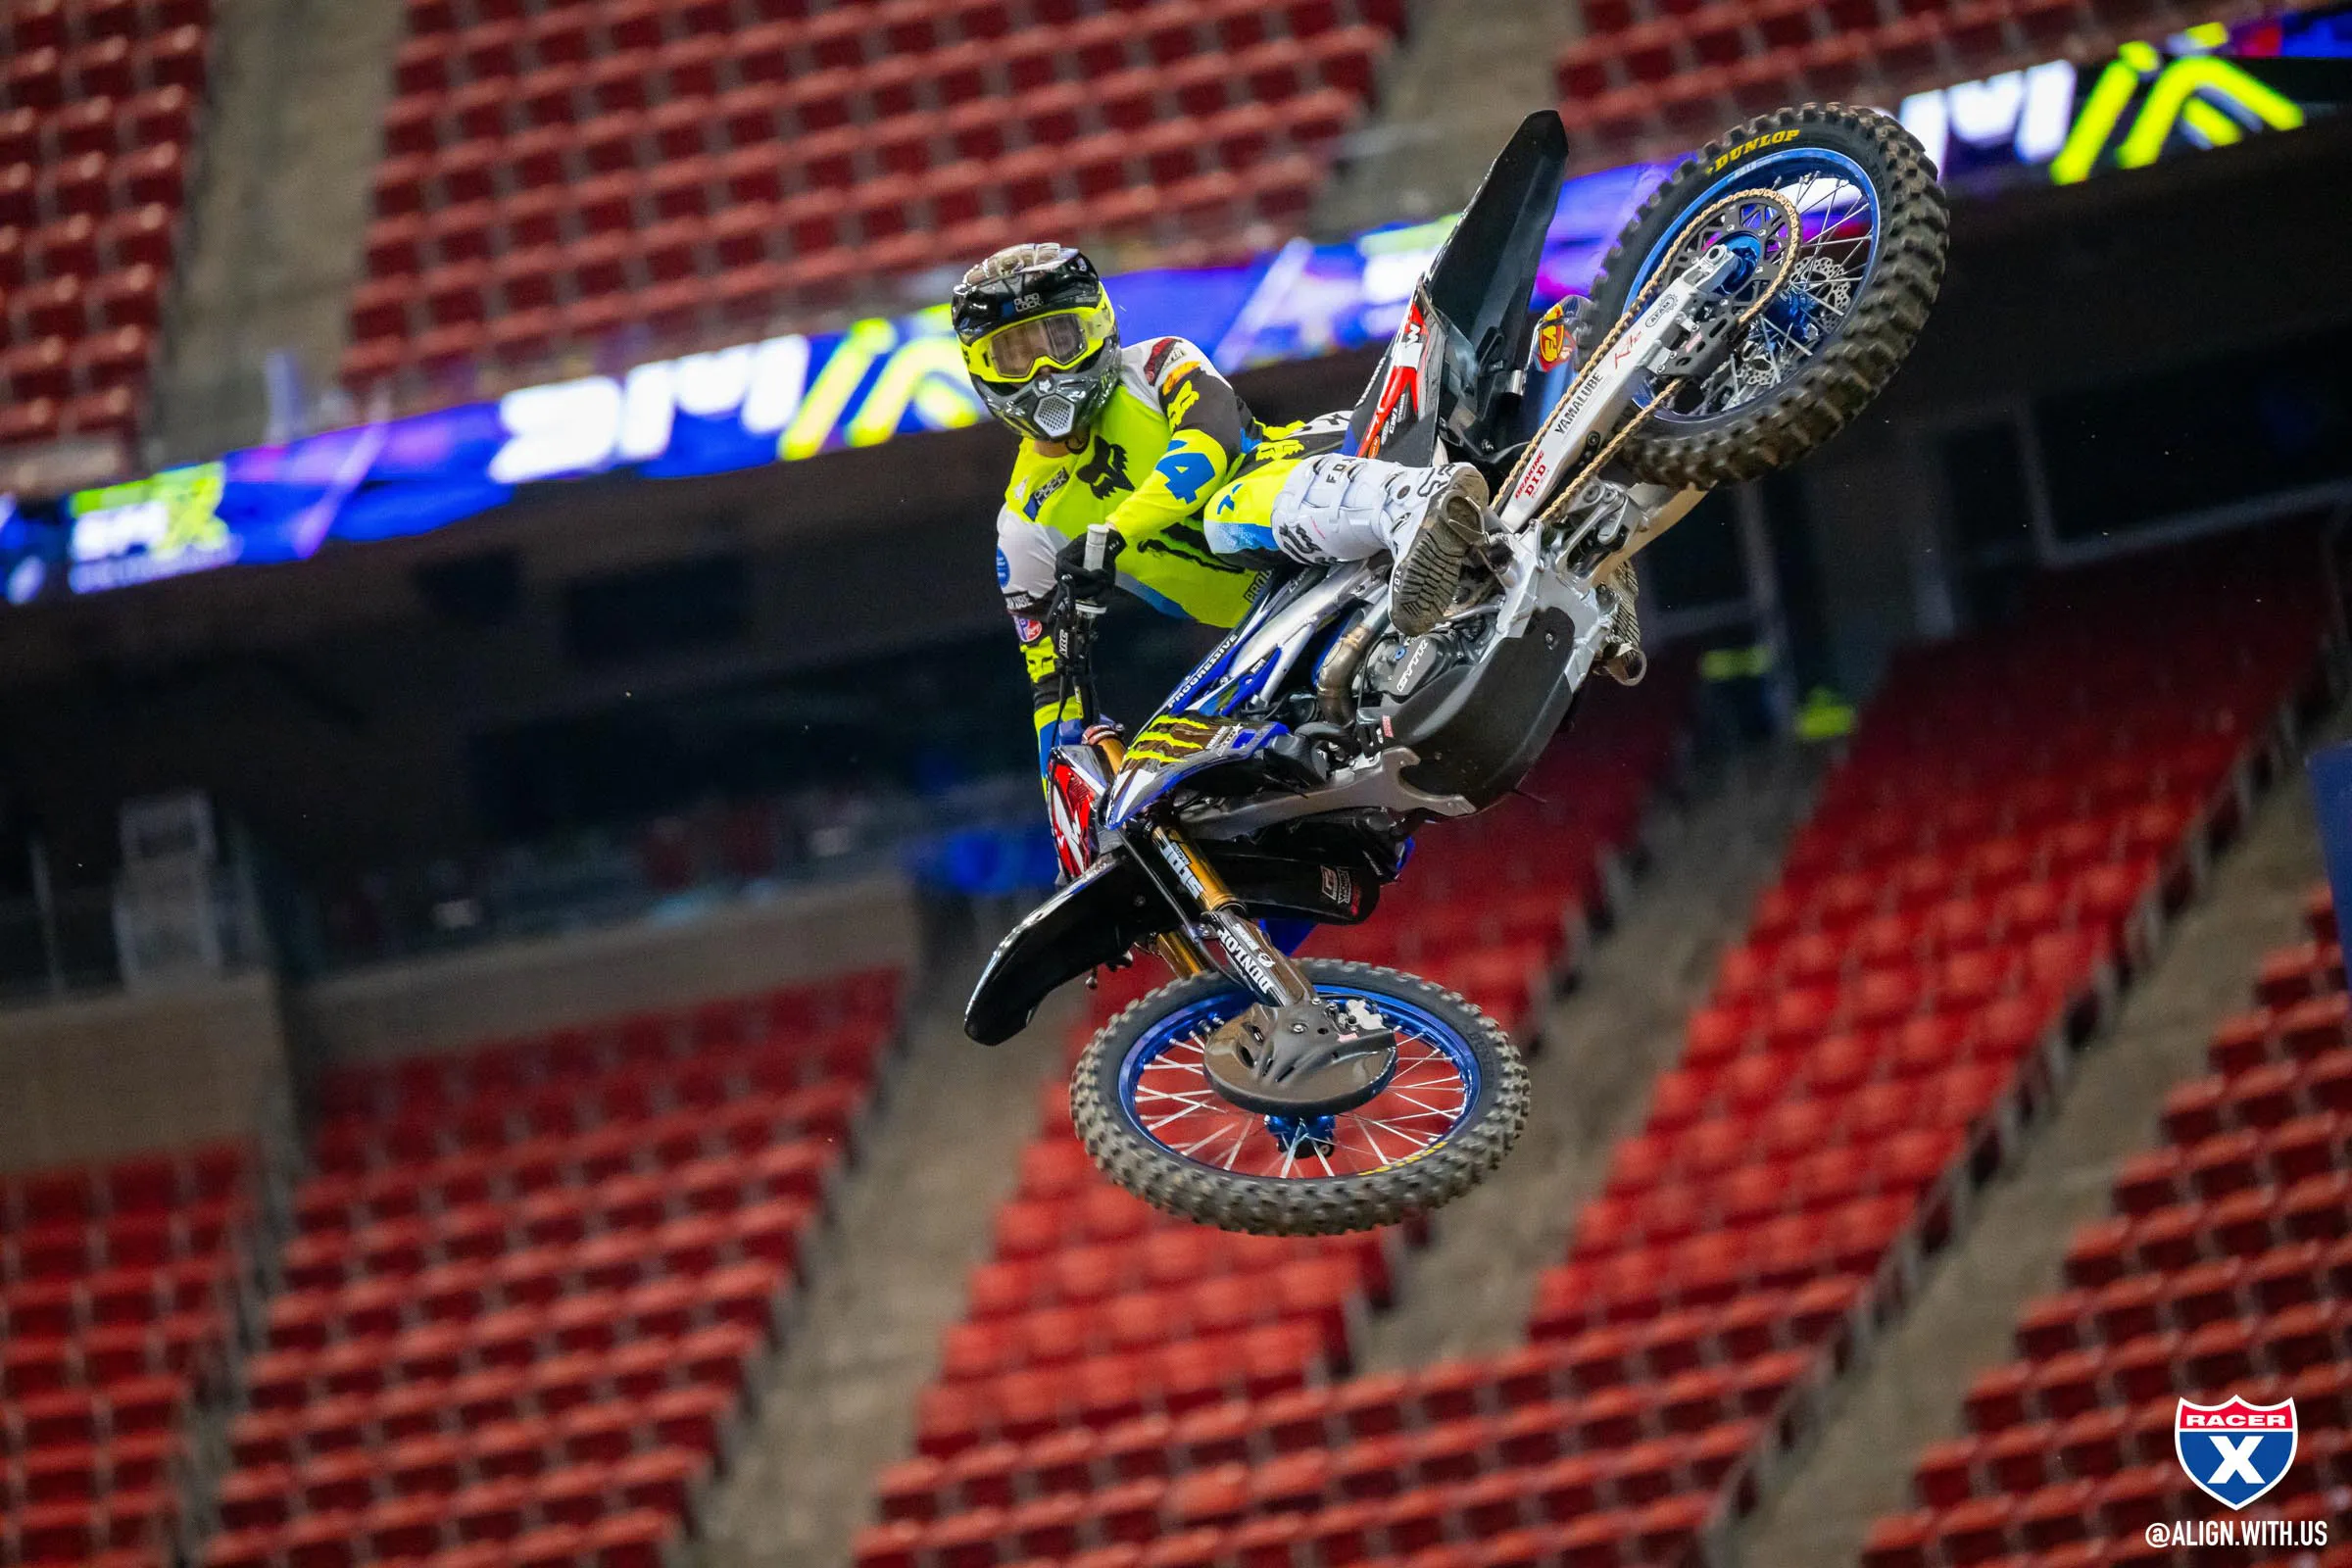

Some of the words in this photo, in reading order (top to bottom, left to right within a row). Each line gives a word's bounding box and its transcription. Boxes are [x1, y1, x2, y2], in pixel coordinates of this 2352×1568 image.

[1715, 129, 1800, 171] DUNLOP
[1554, 372, 1604, 435] YAMALUBE
[1514, 451, 1544, 500] BRAKING
[1168, 634, 1238, 709] PROGRESSIVE
[1217, 929, 1275, 994] DUNLOP
